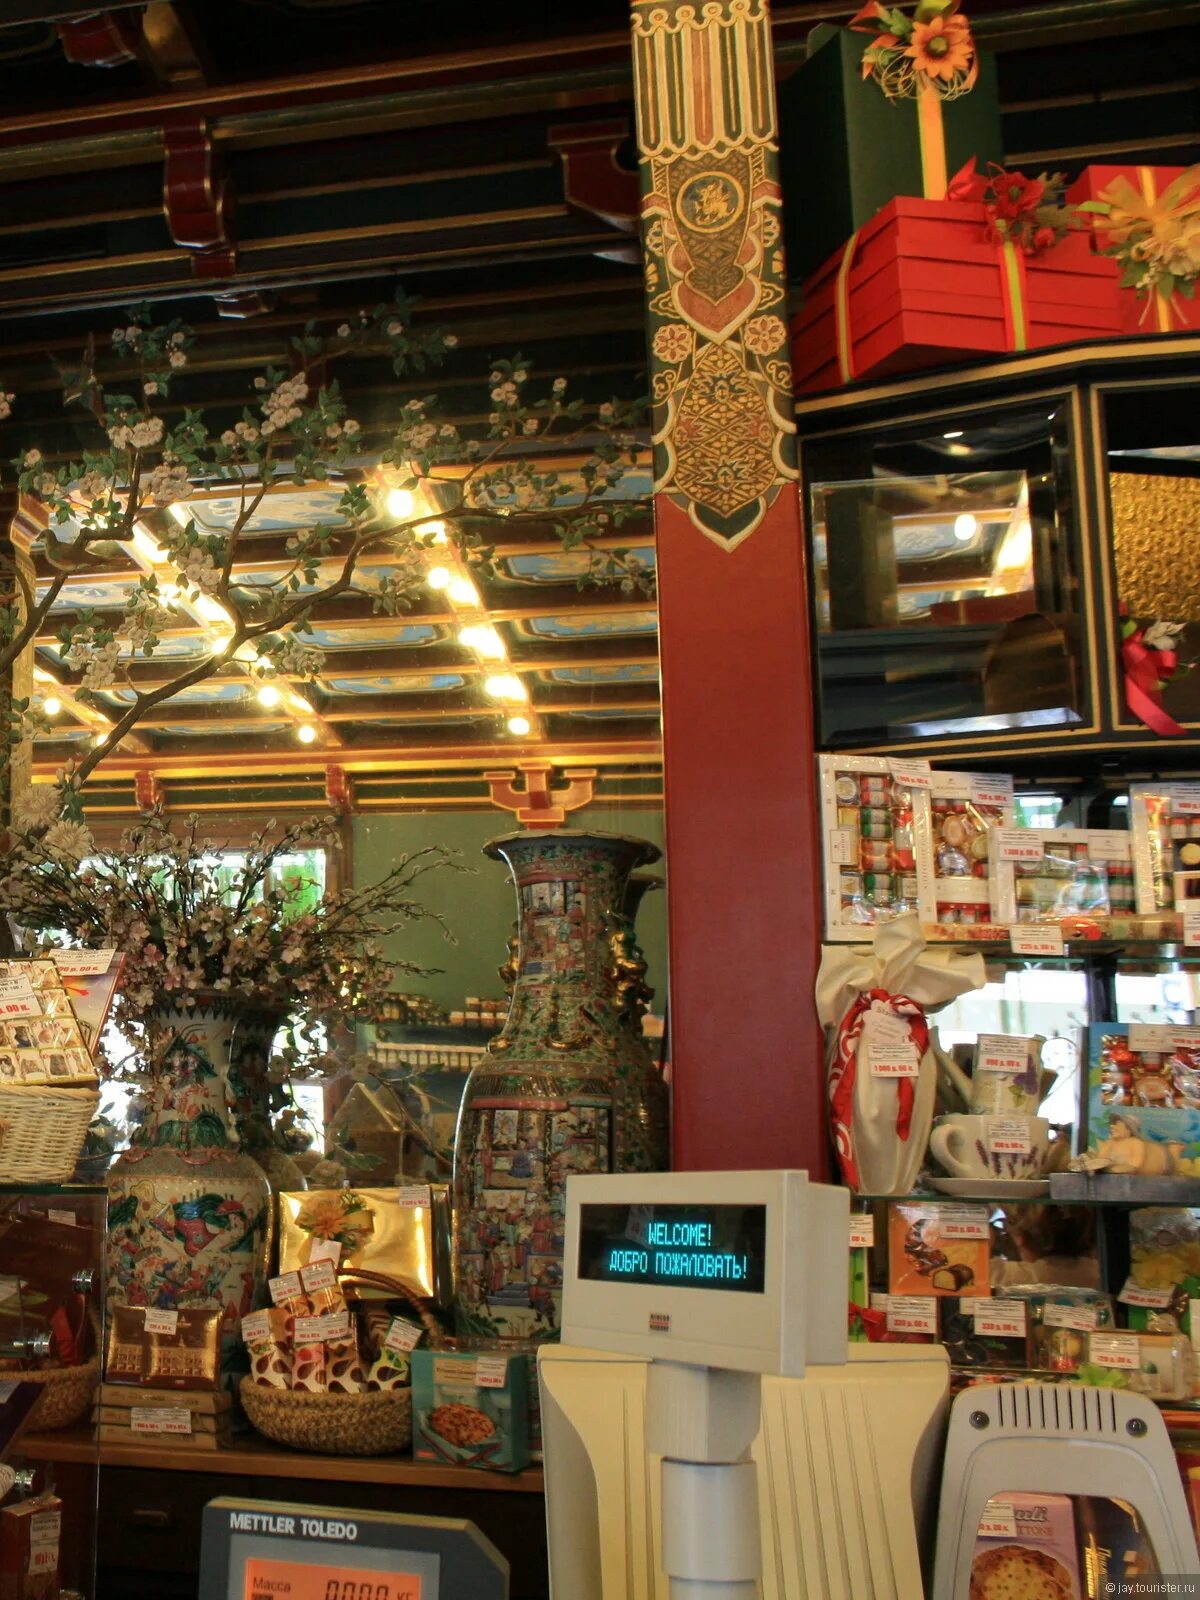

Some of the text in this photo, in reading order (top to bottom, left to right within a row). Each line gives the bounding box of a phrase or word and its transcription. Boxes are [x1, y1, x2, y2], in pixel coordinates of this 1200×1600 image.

[5, 1004, 19, 1013] 00
[648, 1223, 712, 1247] WELCOME!
[609, 1250, 748, 1279] ДОБРО ПОЖАЛОВАТЬ!
[230, 1512, 358, 1541] METTLER TOLEDO
[252, 1576, 291, 1593] Масса
